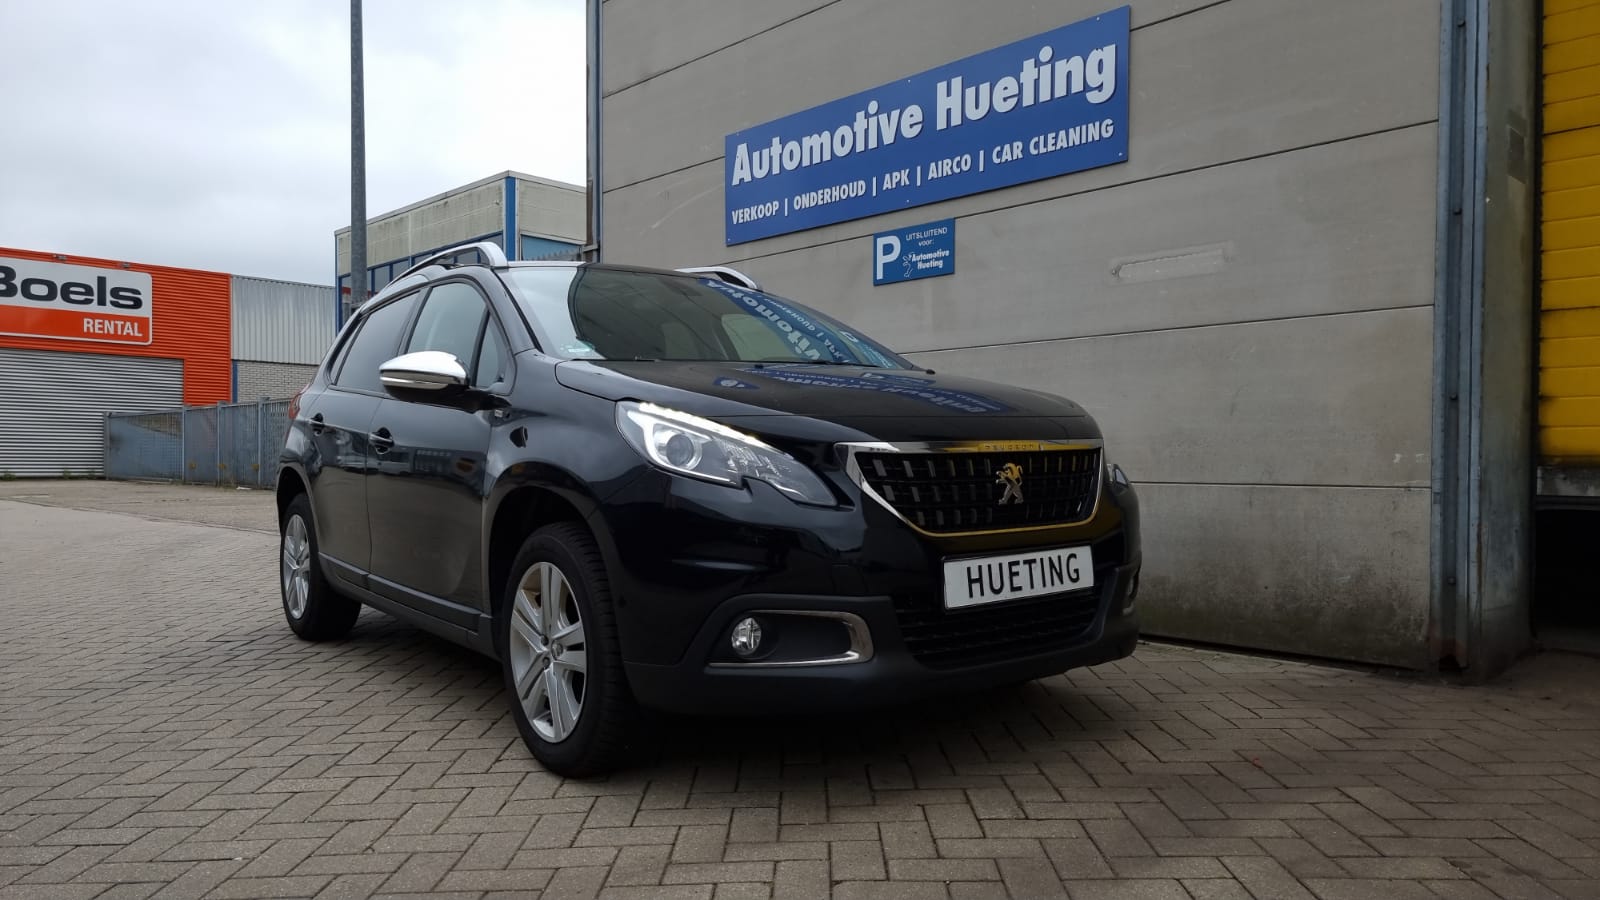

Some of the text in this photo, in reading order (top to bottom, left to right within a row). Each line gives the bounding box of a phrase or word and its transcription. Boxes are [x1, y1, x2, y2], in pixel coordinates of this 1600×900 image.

[731, 44, 1116, 186] Automotive Hueting
[732, 200, 780, 225] VERKOOP
[793, 179, 866, 210] ONDERHOUD
[882, 168, 910, 191] APK
[927, 153, 972, 181] AIRCO
[992, 141, 1023, 164] CAR
[1029, 118, 1114, 156] CLEANING
[905, 226, 948, 241] UITSLUITEND
[876, 235, 901, 280] P
[911, 249, 950, 262] Automotive
[917, 259, 943, 270] Hueting
[83, 318, 143, 337] RENTAL
[966, 552, 1080, 599] HUETING
